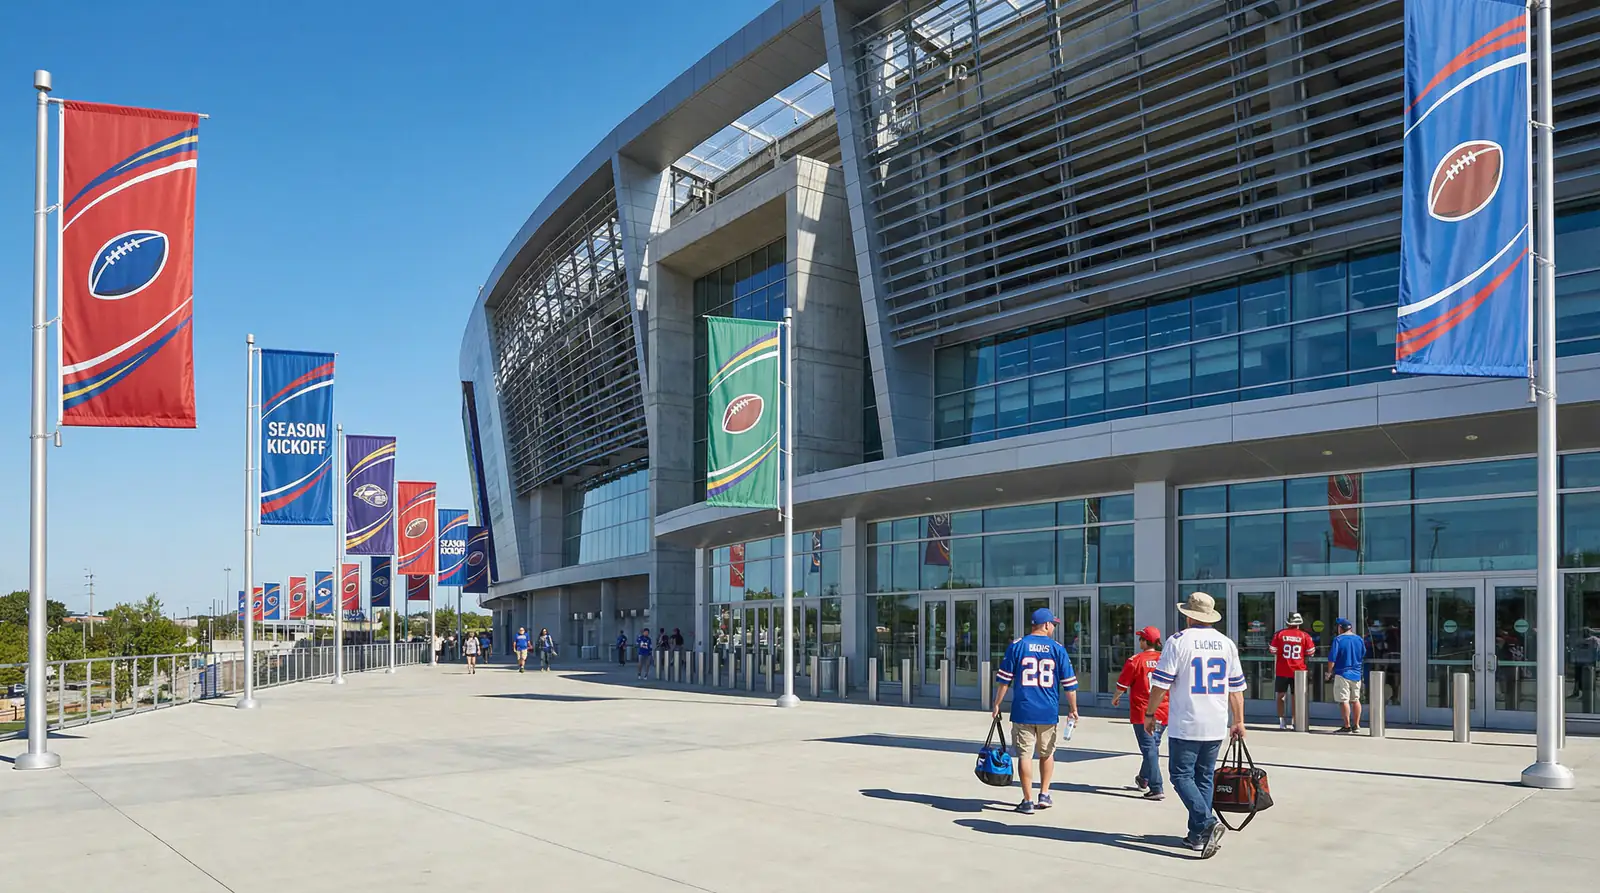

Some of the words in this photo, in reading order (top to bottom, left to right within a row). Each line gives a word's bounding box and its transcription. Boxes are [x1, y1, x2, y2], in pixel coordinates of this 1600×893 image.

[268, 421, 327, 438] SEASON
[267, 438, 327, 455] KICKOFF
[1282, 643, 1302, 660] 98
[1021, 655, 1056, 688] 28
[1189, 656, 1227, 695] 12
